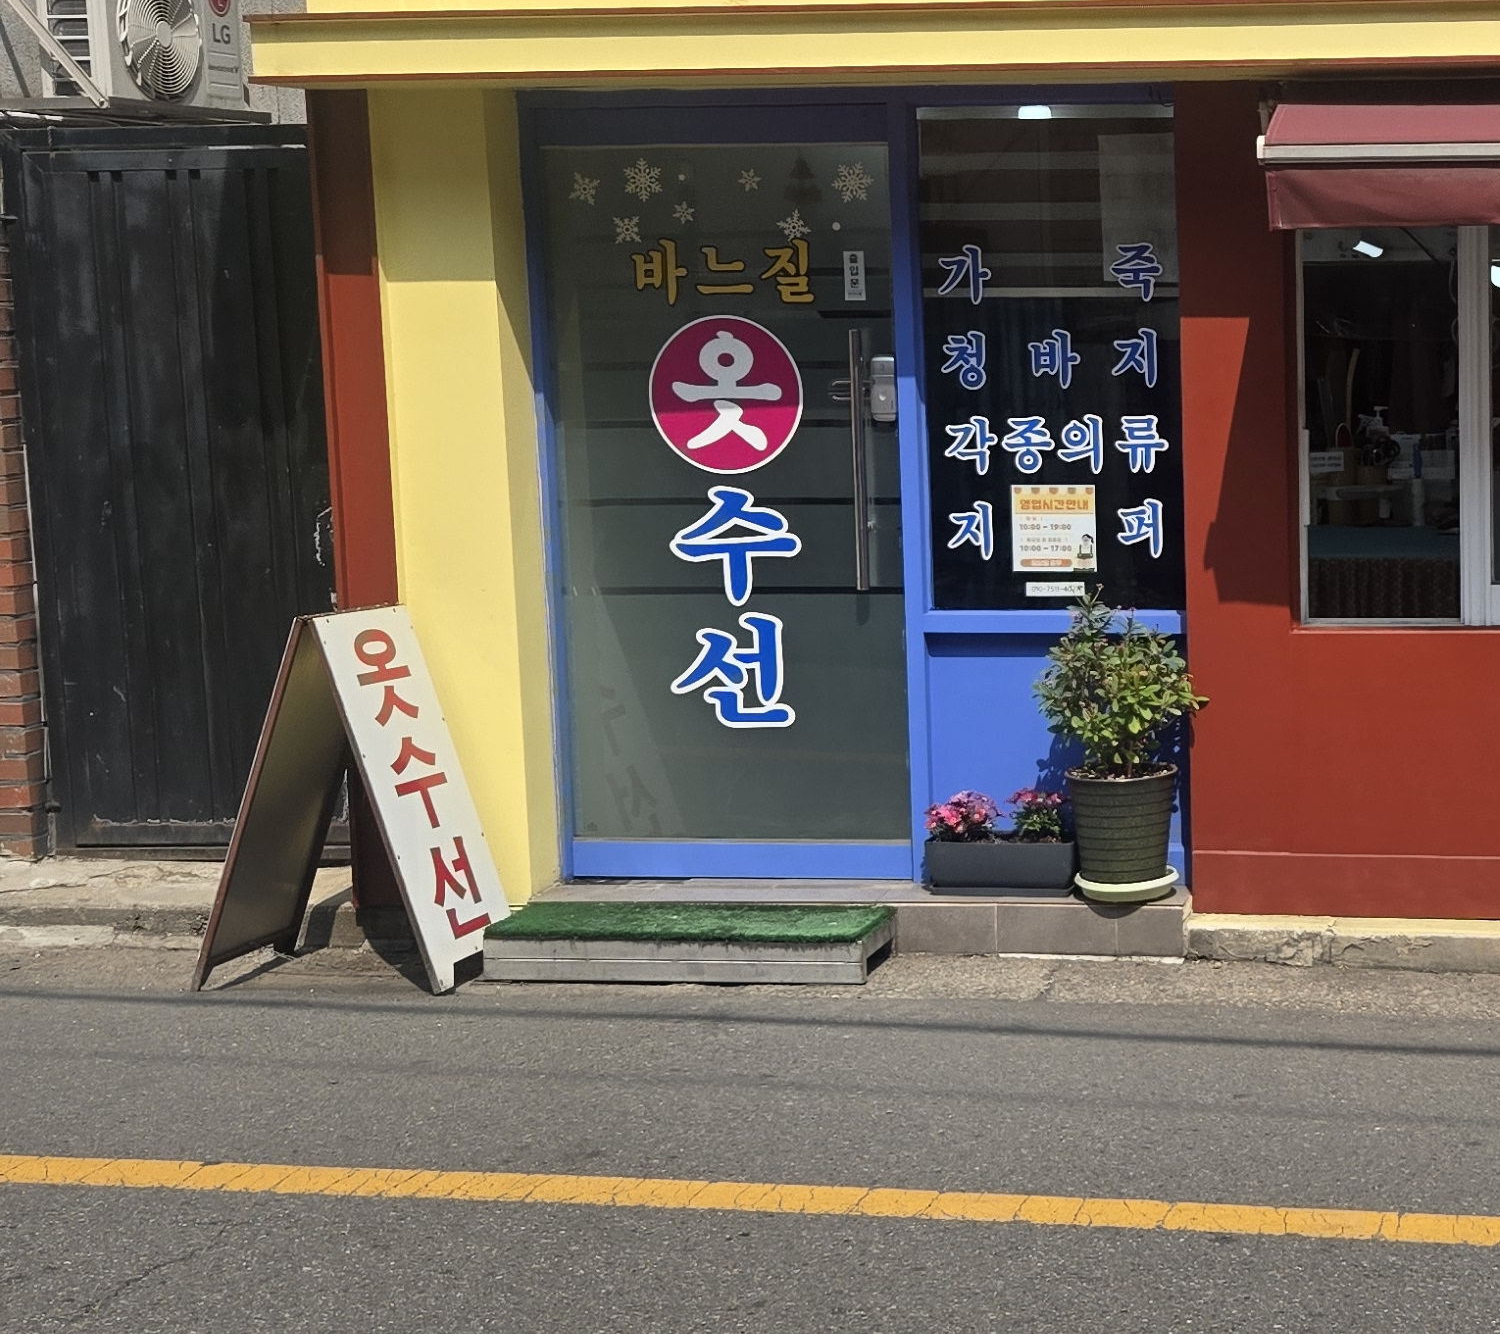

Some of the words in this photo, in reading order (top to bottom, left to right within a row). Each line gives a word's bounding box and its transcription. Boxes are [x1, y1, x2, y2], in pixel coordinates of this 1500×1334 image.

[212, 22, 231, 44] LG
[630, 237, 816, 306] 바느질
[672, 329, 782, 451] 옷
[944, 414, 1169, 476] 각종의류
[1020, 499, 1089, 510] 영업시간안내
[670, 485, 801, 729] 수선
[353, 629, 491, 940] 옷수선
